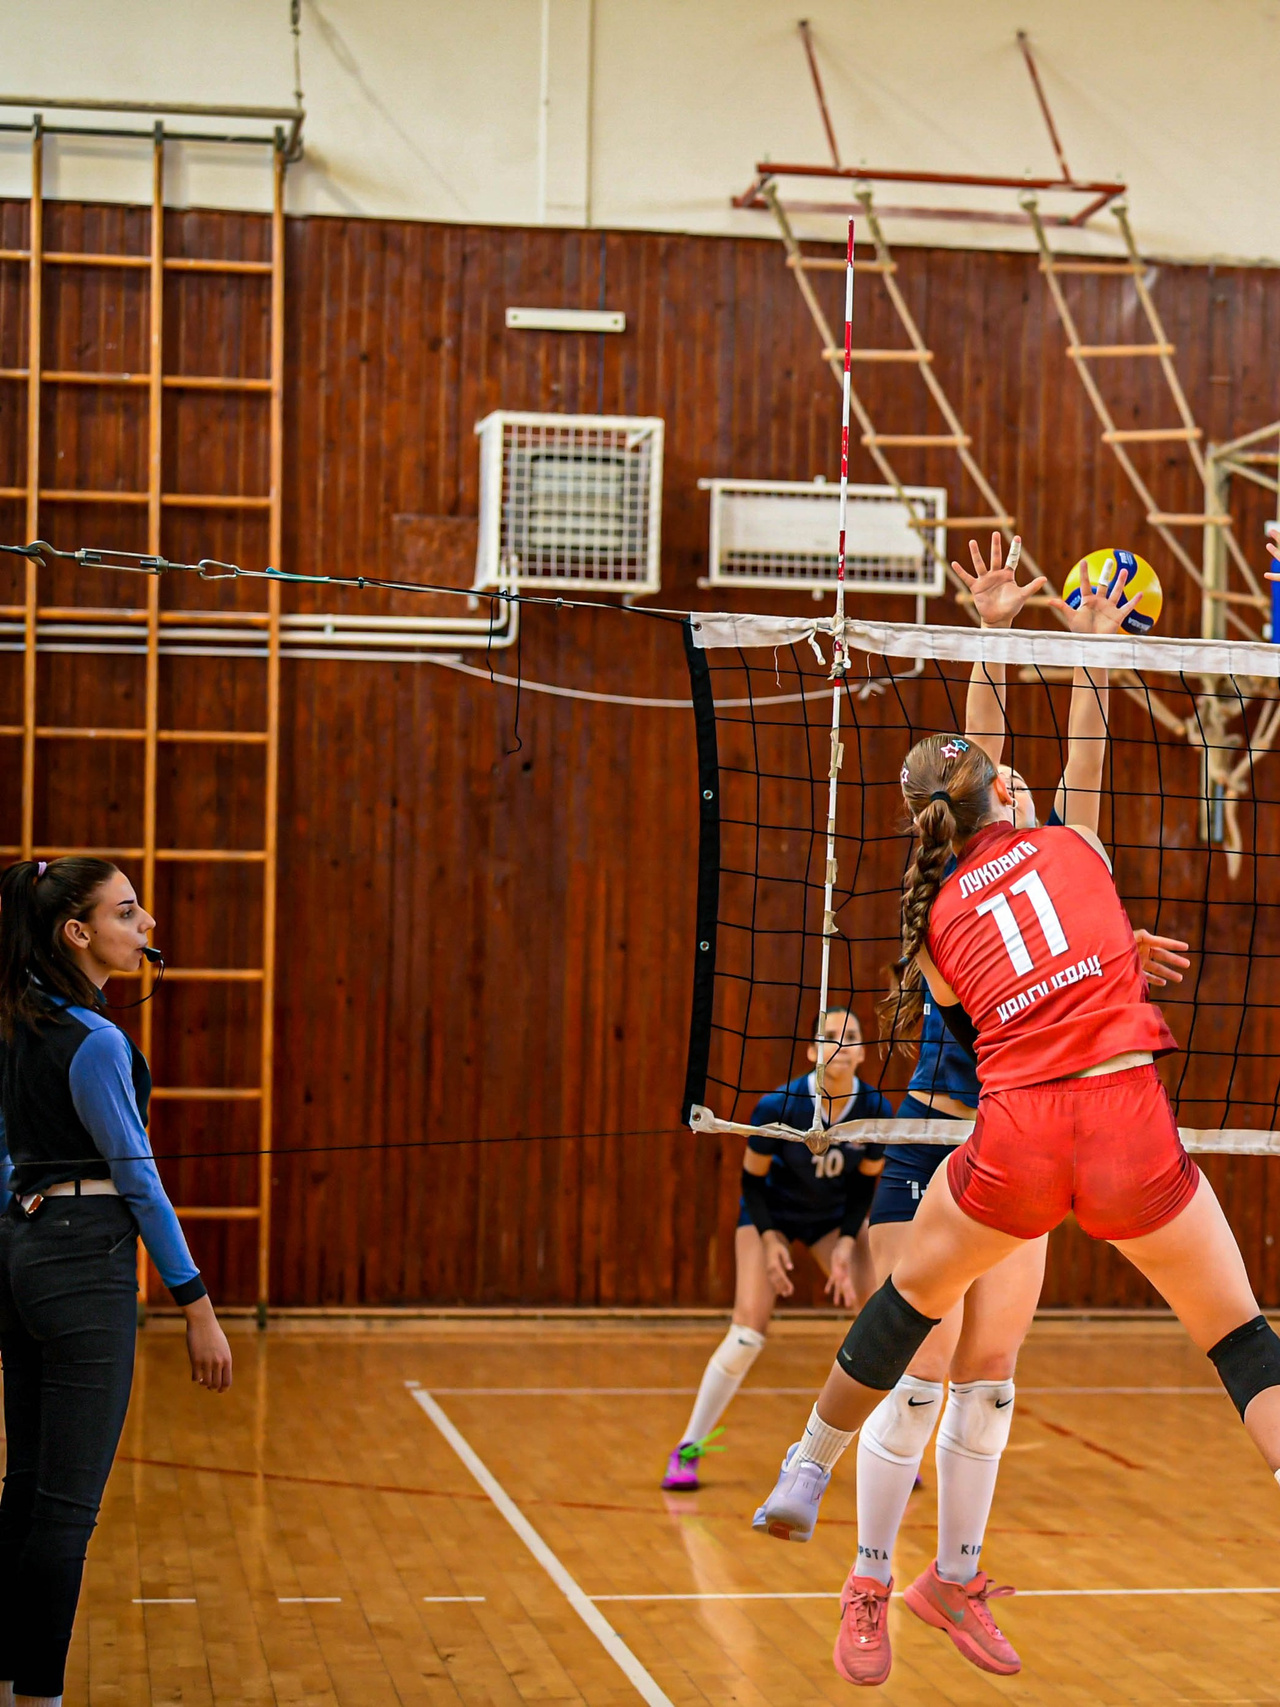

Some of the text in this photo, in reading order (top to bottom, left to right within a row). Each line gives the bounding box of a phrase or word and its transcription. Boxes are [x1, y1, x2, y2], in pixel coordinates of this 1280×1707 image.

[958, 841, 1039, 899] ЛУКОВИЋ
[975, 869, 1069, 977] 11
[811, 1149, 844, 1178] 10
[906, 1180, 929, 1199] 1
[858, 1545, 889, 1560] PSTA
[960, 1543, 982, 1556] KIP
